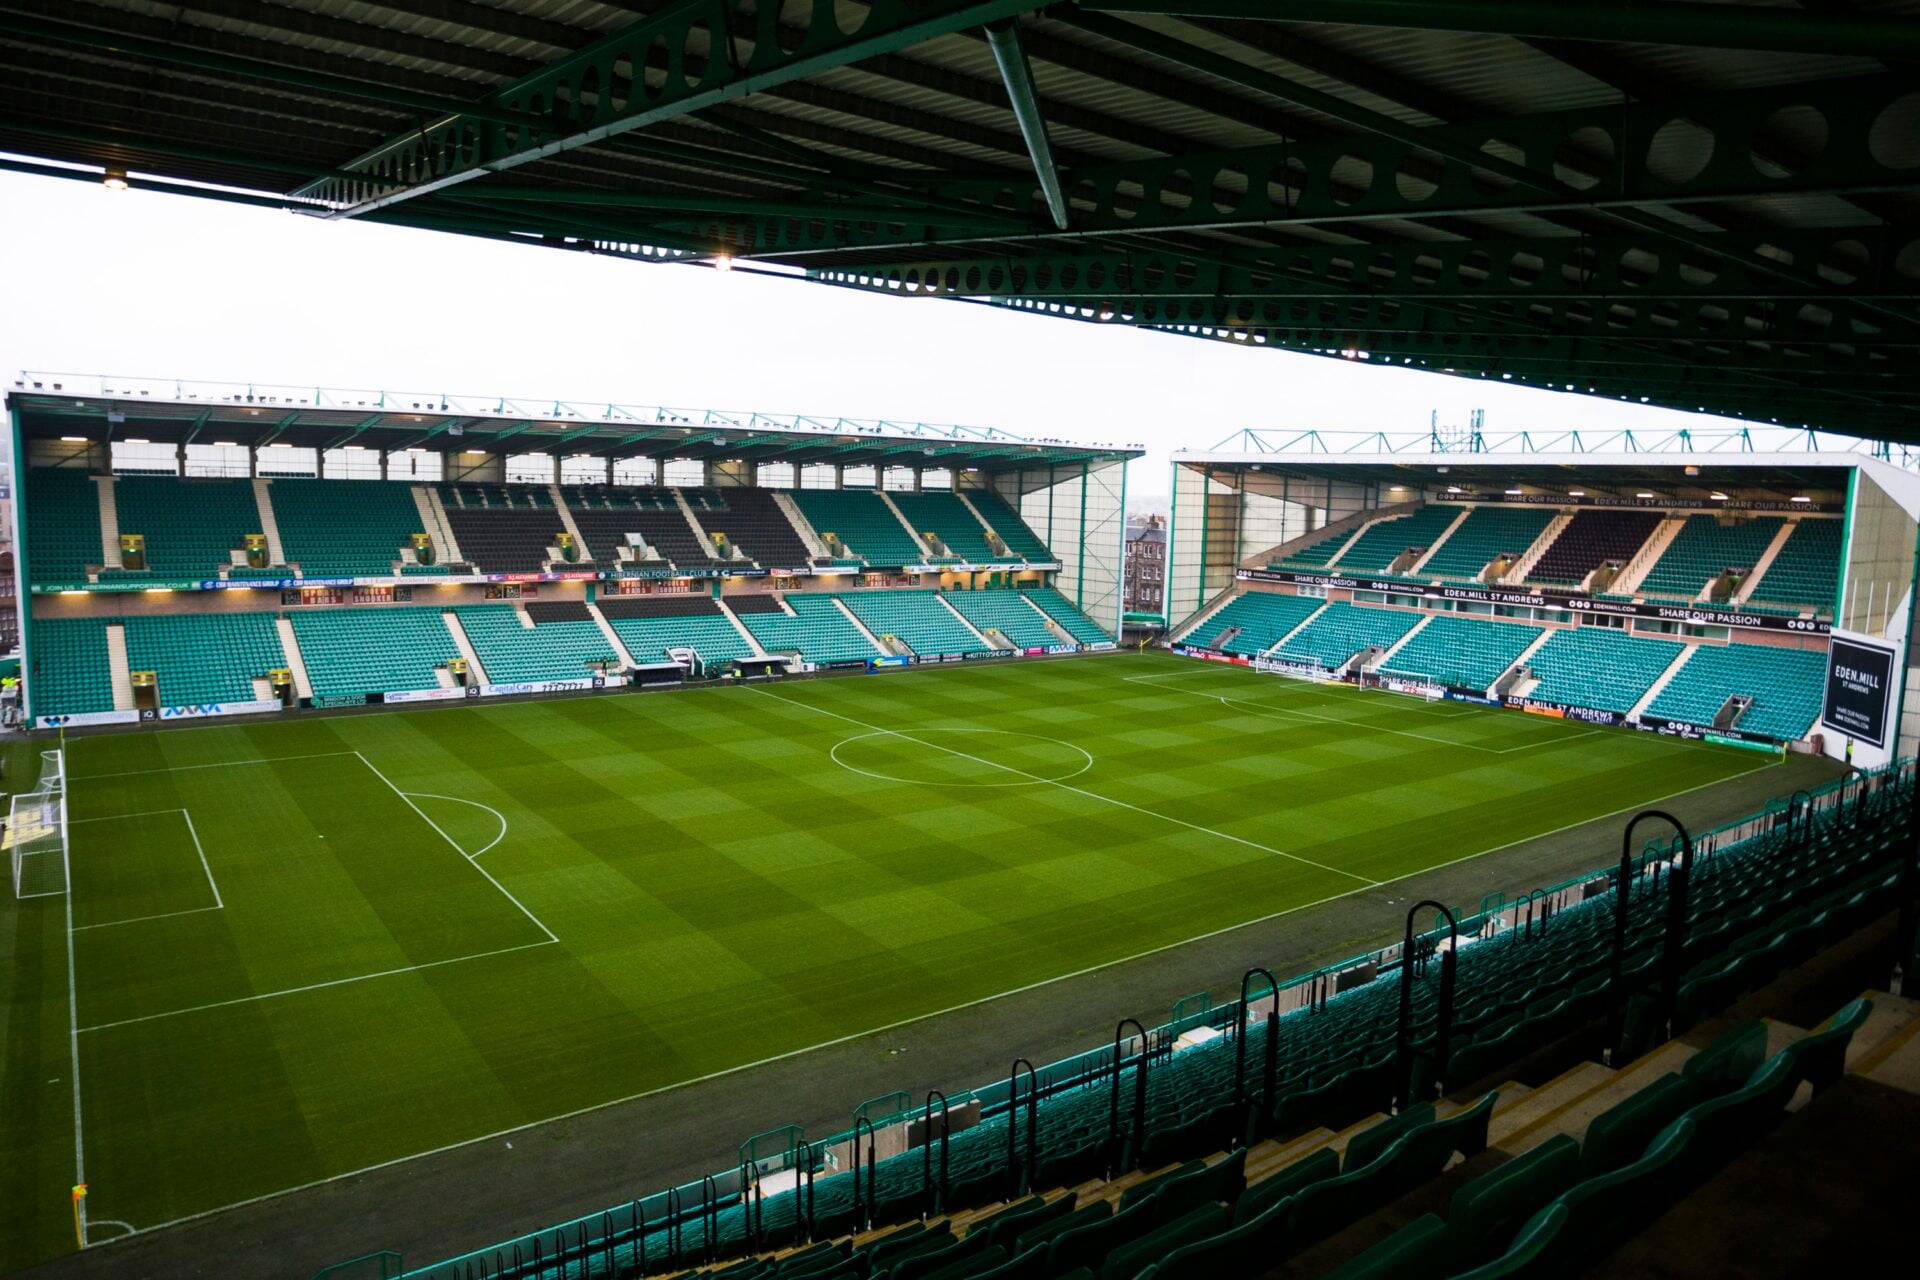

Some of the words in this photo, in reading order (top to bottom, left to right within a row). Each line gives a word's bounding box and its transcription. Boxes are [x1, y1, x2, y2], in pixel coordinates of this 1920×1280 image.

[1547, 496, 1579, 504] PASSION
[1657, 499, 1703, 508] ANDREWS
[1722, 501, 1751, 509] SHARE
[1754, 502, 1776, 510] OUR
[1778, 502, 1821, 512] PASSION
[611, 571, 650, 579] HIBERNIAN
[652, 570, 688, 578] FOOTBALL
[689, 569, 707, 577] CLUB
[1294, 575, 1314, 584] SHARE
[1315, 577, 1329, 585] OUR
[1330, 577, 1357, 587] PASSION
[1444, 589, 1488, 600] EDEN.MILL
[1490, 593, 1500, 601] ST
[1502, 594, 1544, 605] ANDREWS
[1593, 603, 1636, 613] EDENMILL.COM
[1658, 608, 1690, 620] SHARE
[1692, 611, 1715, 621] OUR
[1717, 614, 1761, 626] PASSION
[1835, 664, 1879, 688] EDEN.MILL
[516, 683, 533, 692] Cars
[1402, 679, 1417, 687] OUR
[1848, 683, 1869, 695] ANDREWS
[1570, 706, 1613, 718] ANDREWS
[1695, 727, 1742, 739] EDENMILL.COM
